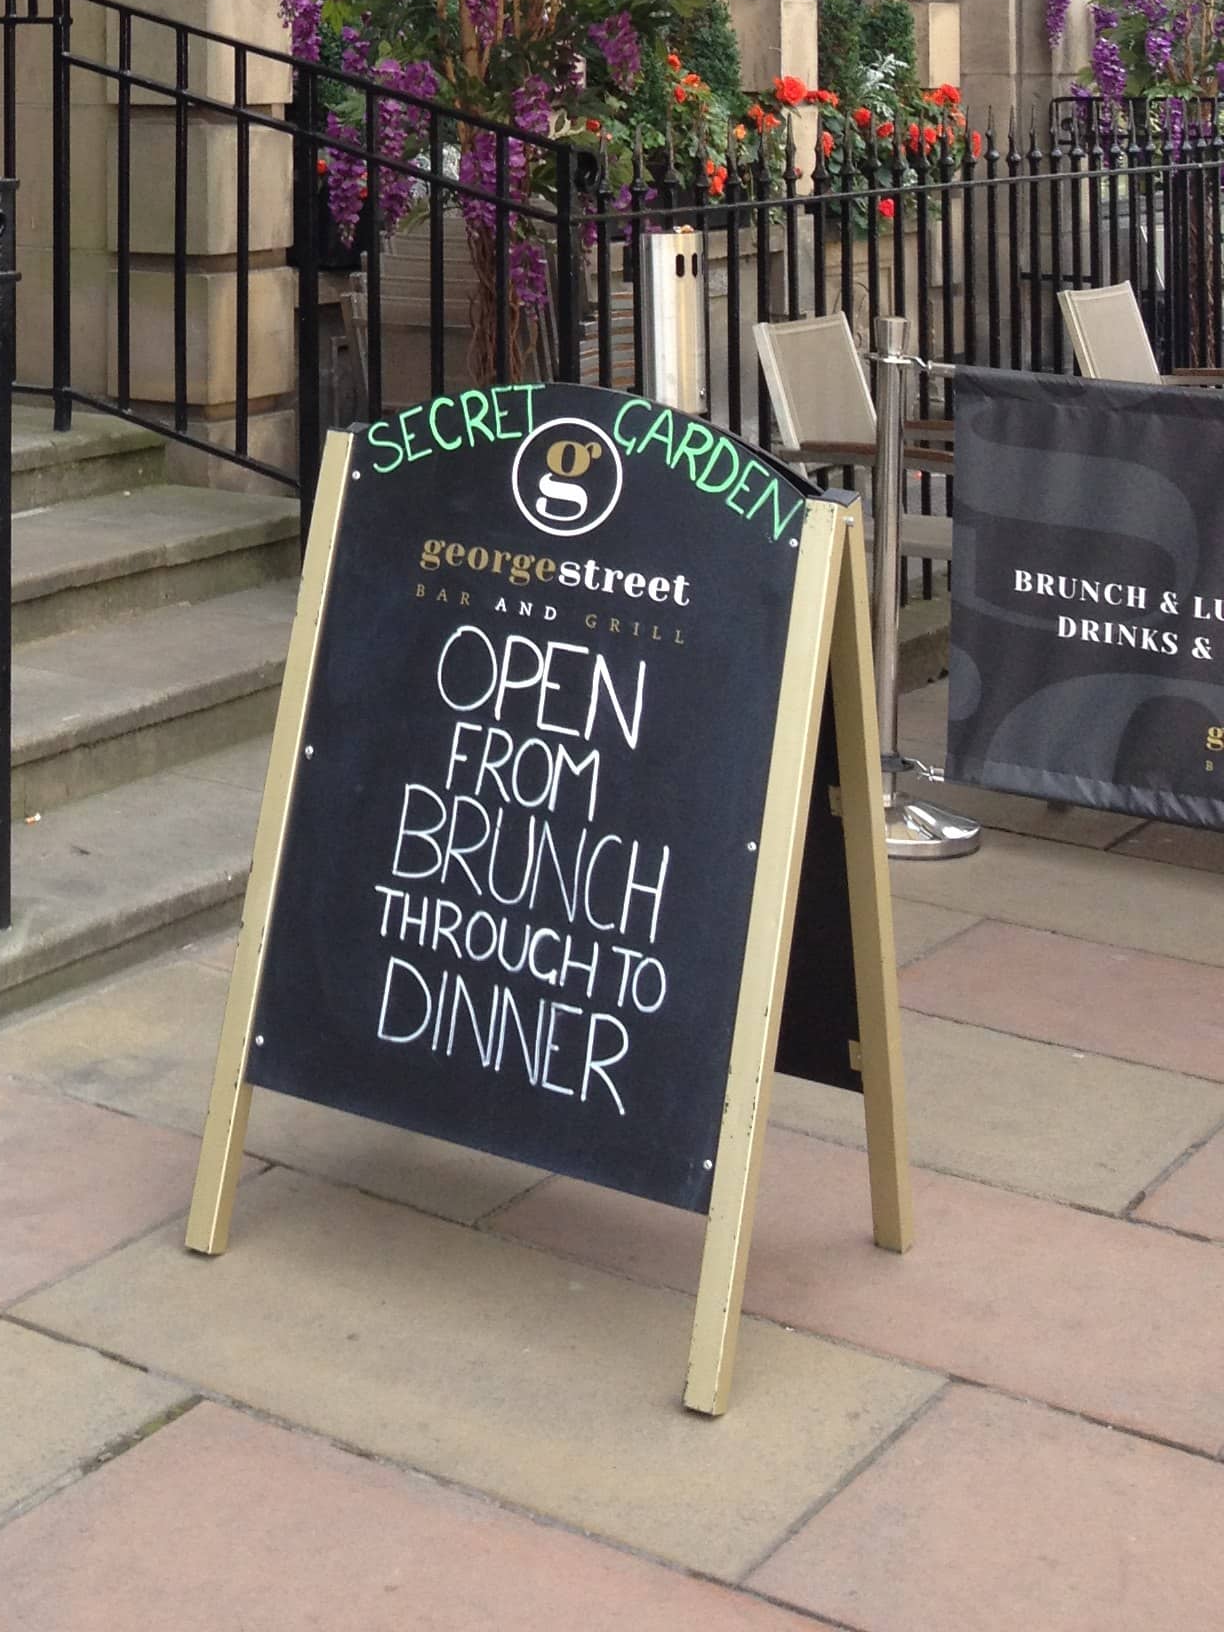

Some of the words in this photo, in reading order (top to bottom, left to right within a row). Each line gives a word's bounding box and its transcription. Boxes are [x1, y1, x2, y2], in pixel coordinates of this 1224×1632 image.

[368, 384, 545, 474] SECRET
[613, 399, 805, 541] GARDEN
[535, 440, 603, 522] g
[415, 583, 471, 606] BAR
[494, 597, 558, 621] AND
[584, 613, 685, 645] GRILL
[1014, 569, 1147, 609] BRUNCH
[1160, 591, 1180, 615] &
[1057, 616, 1178, 655] DRINKS
[1191, 636, 1213, 660] &
[437, 625, 646, 750] OPEN
[445, 722, 600, 821] FROM
[392, 783, 670, 943] BRUNCH
[375, 885, 599, 998] THROUGH
[612, 945, 667, 1013] TO
[377, 956, 629, 1116] DINNER
